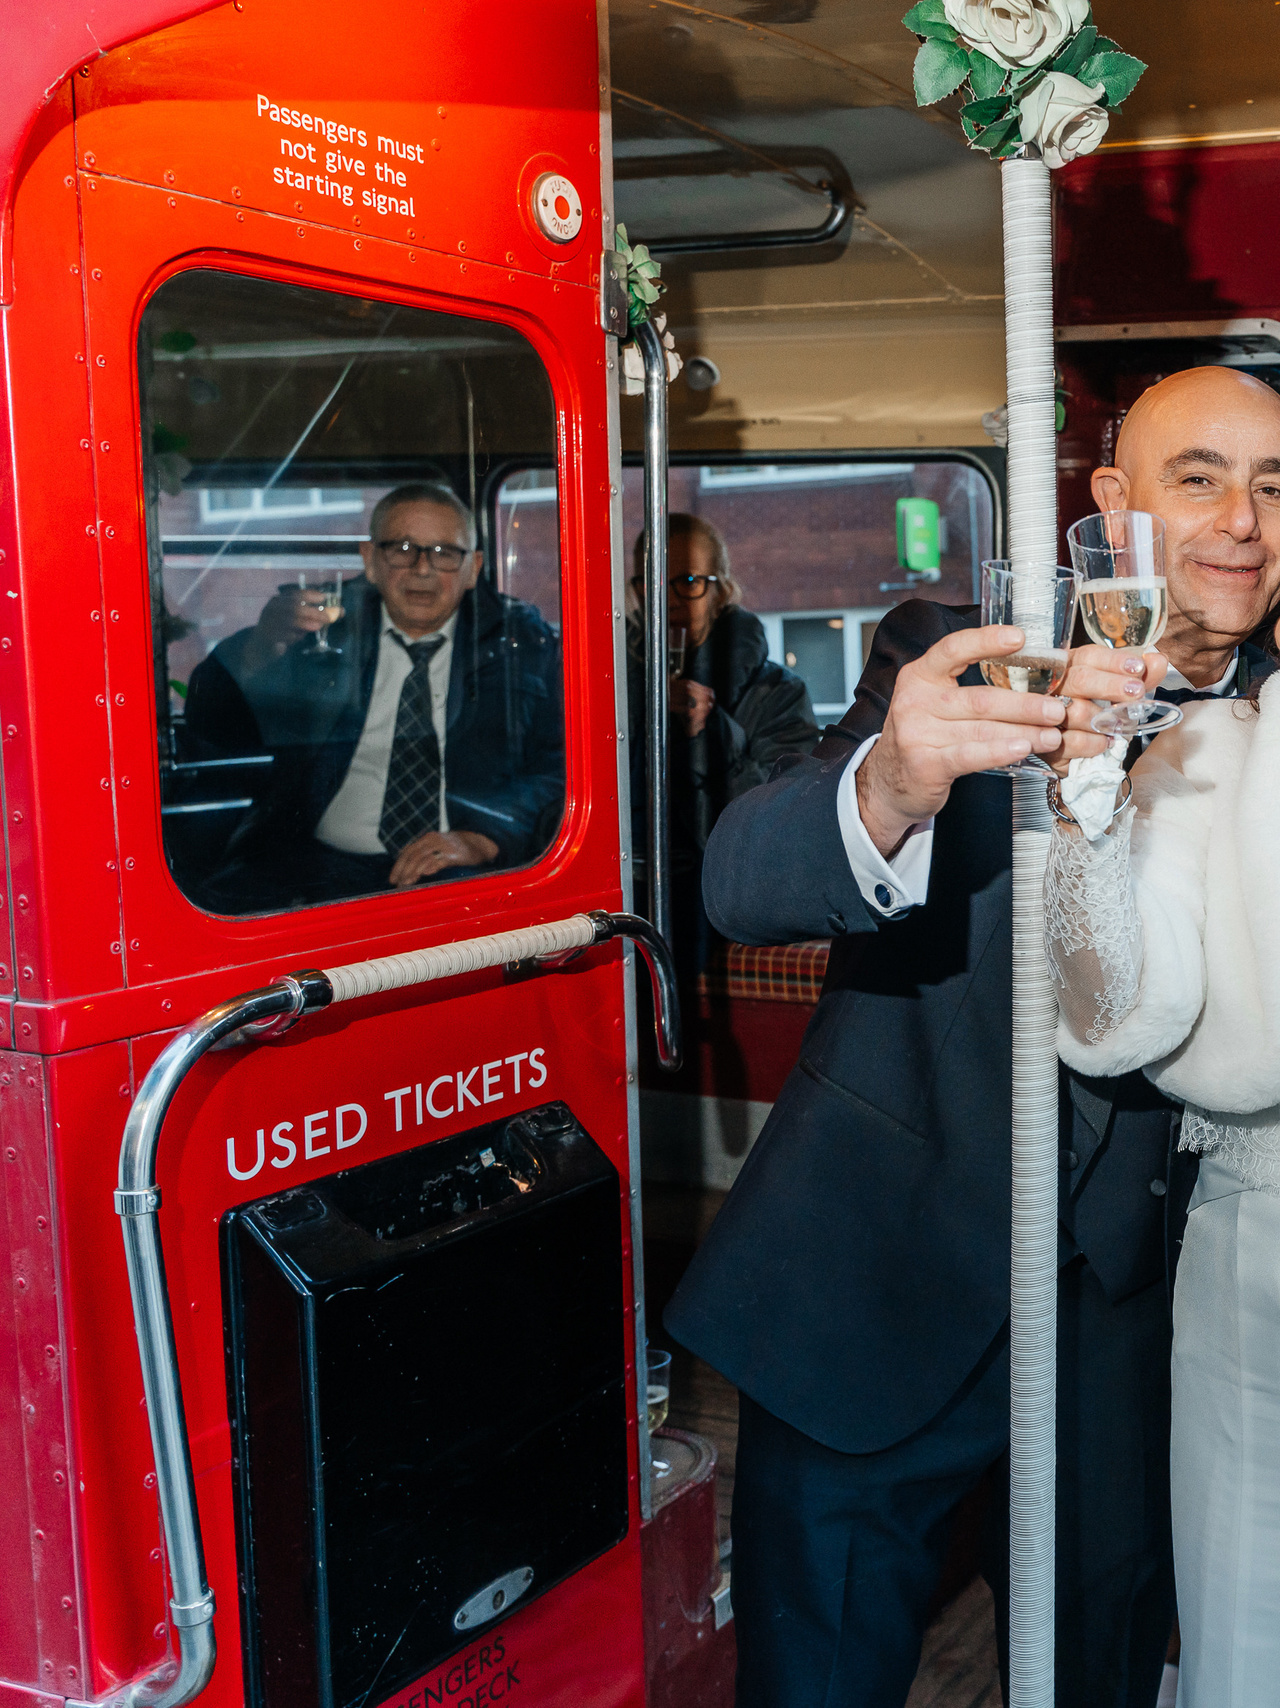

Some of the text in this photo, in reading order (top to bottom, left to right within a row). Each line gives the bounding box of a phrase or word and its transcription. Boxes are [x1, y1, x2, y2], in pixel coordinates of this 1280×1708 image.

[257, 93, 425, 165] Passengers must
[280, 138, 407, 188] not give the
[273, 166, 416, 218] starting signal
[226, 1047, 548, 1182] USED TICKETS
[397, 1635, 506, 1708] ENGERS
